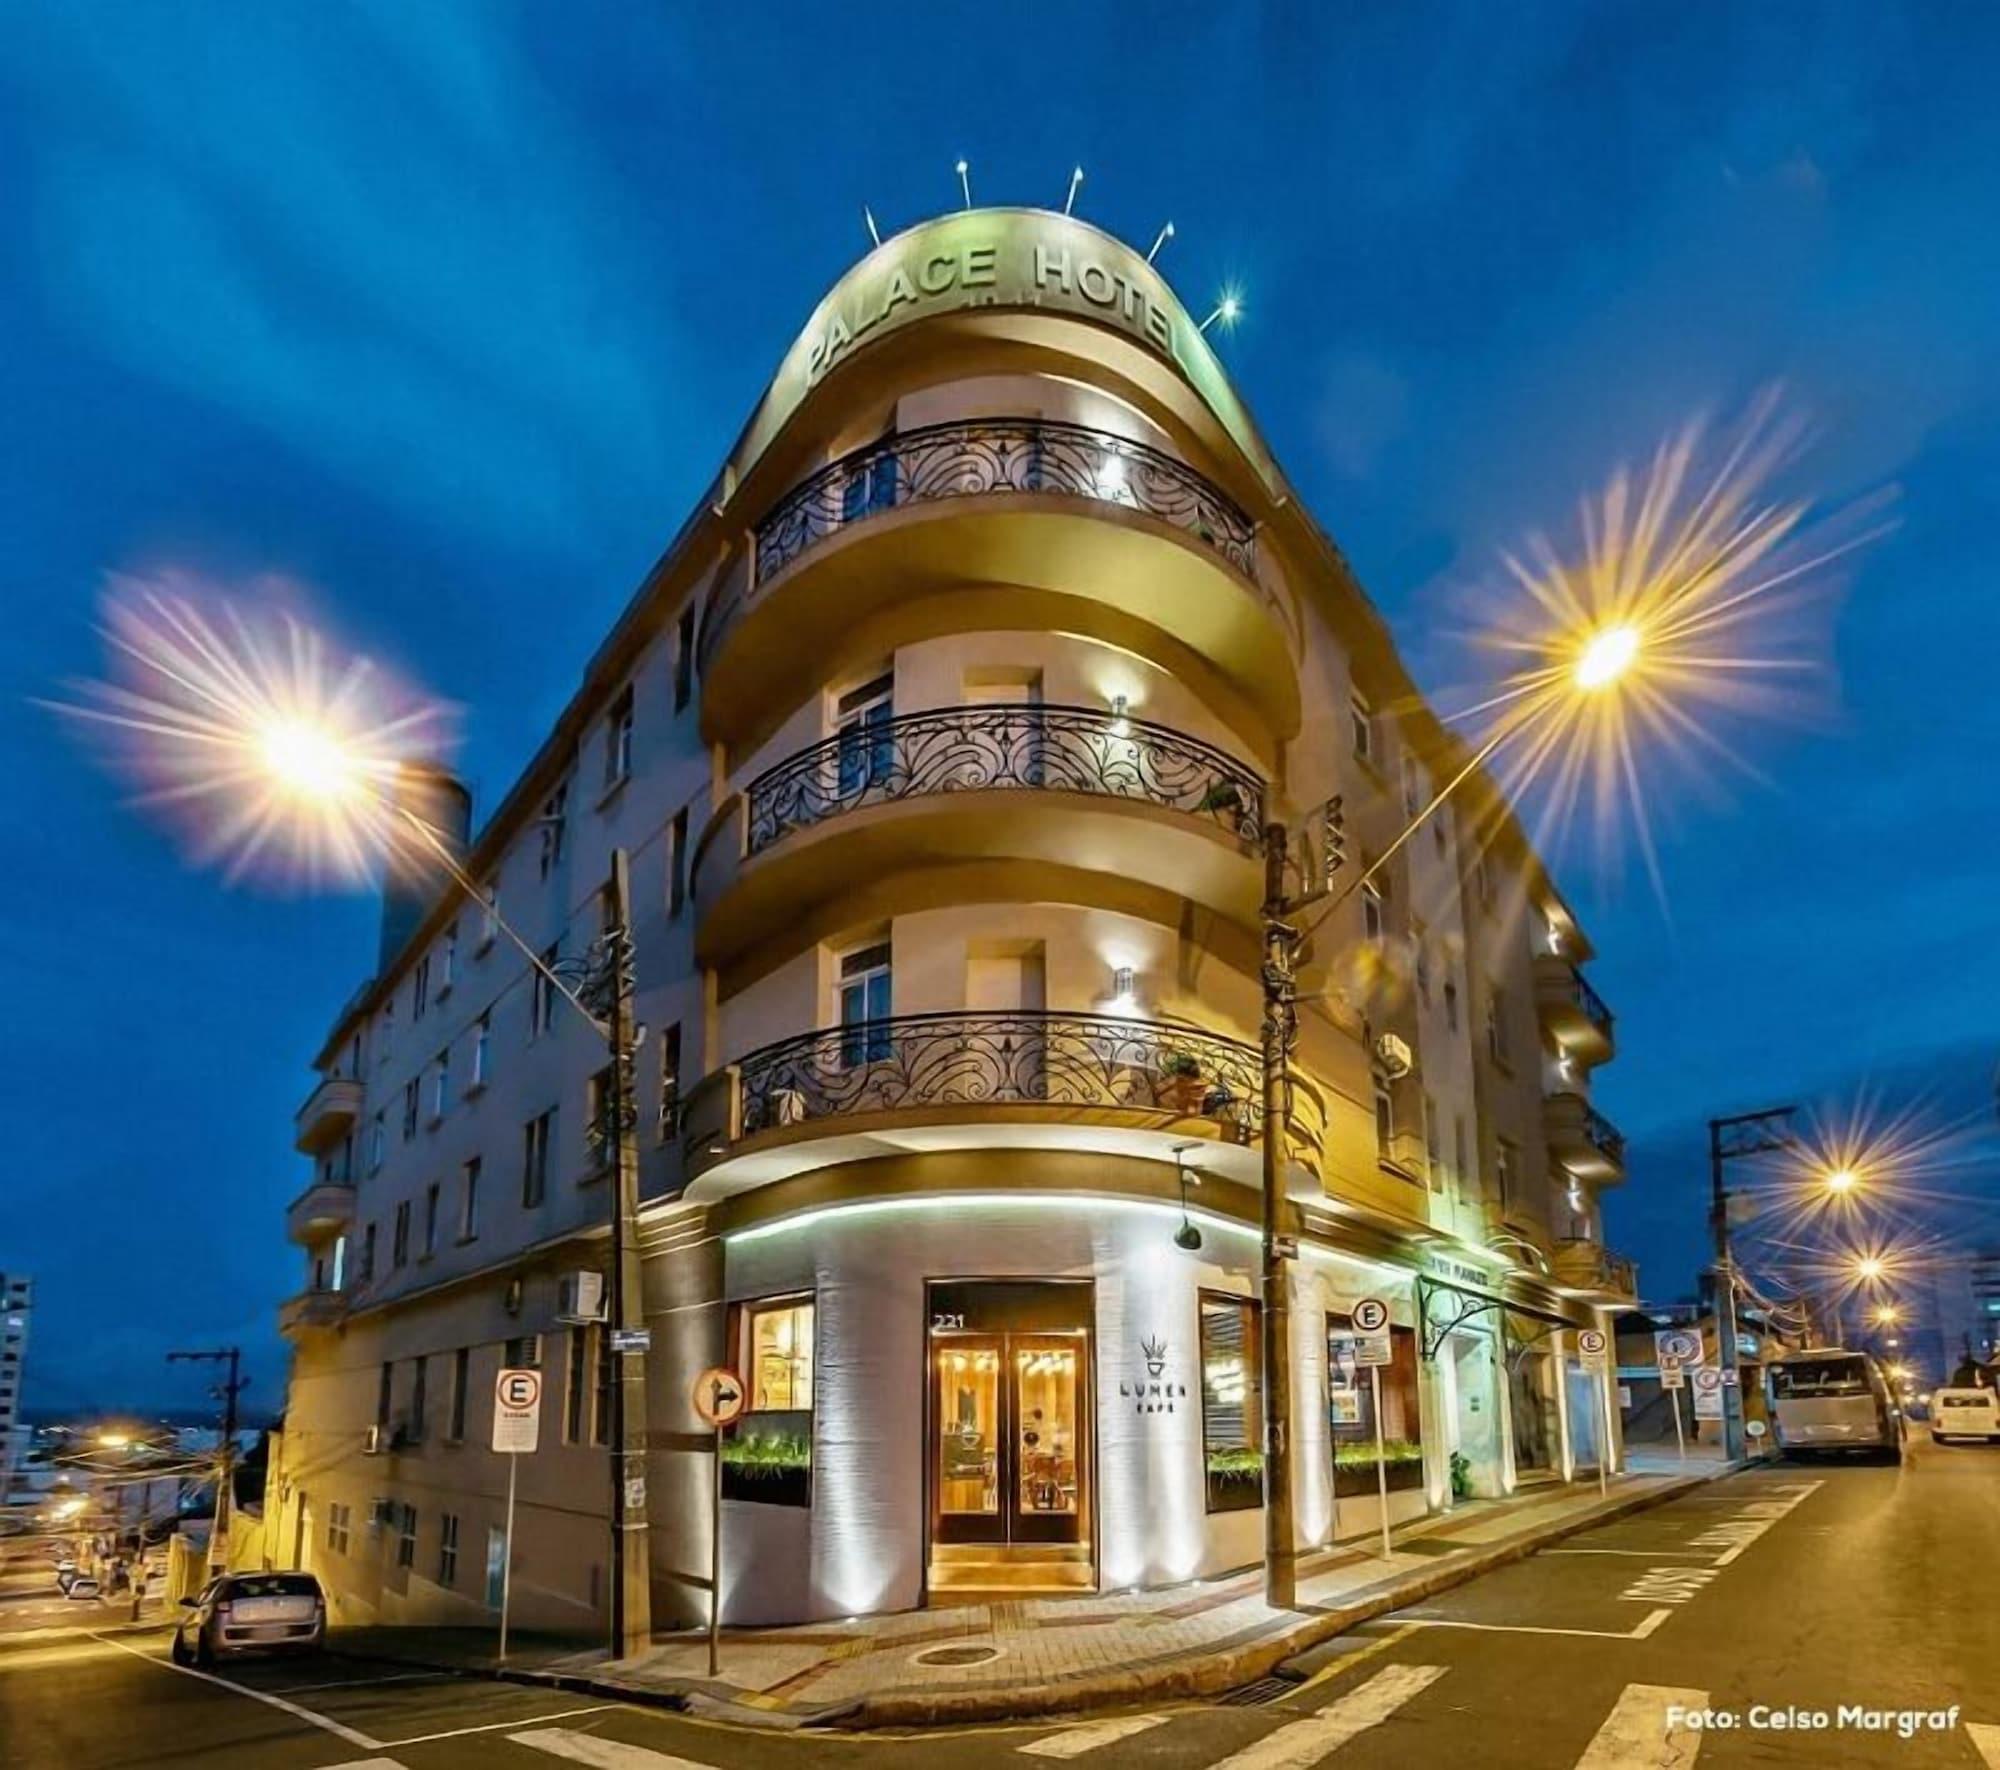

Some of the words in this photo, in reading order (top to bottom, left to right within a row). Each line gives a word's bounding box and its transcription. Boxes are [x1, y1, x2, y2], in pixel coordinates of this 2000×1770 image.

[806, 247, 997, 378] PALACE
[933, 1313, 965, 1329] 221
[1363, 1304, 1377, 1326] E
[510, 1378, 529, 1403] E
